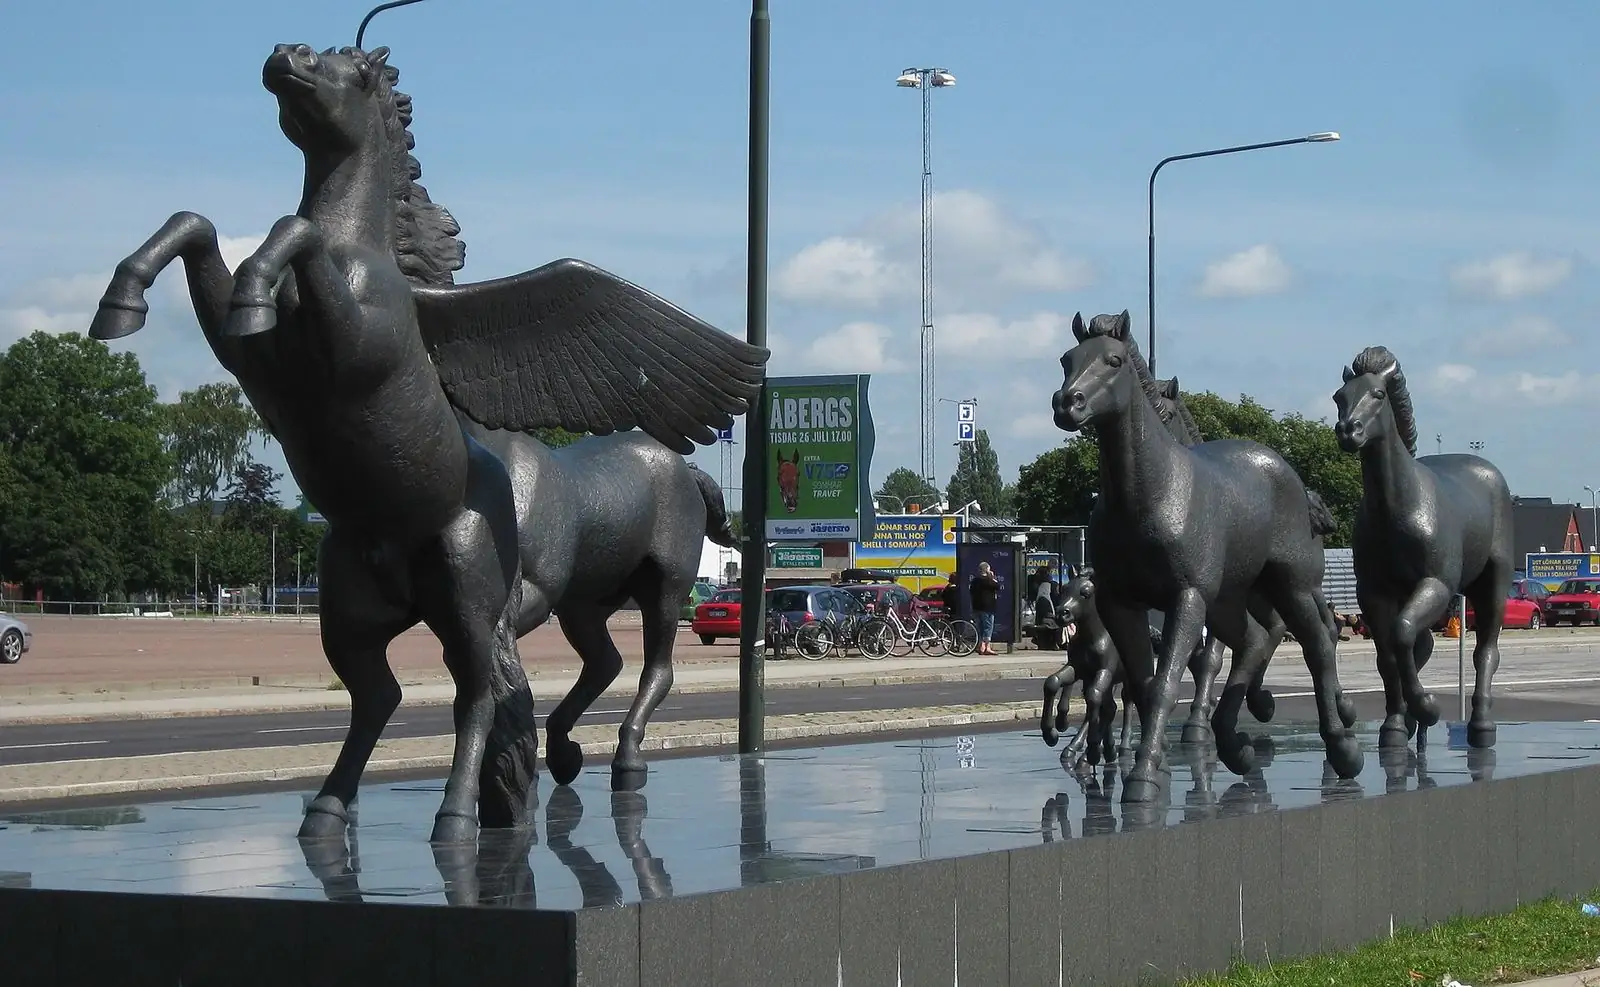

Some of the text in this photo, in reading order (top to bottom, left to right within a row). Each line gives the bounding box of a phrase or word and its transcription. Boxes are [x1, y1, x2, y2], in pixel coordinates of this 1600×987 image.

[770, 391, 852, 429] ÅBERGS
[962, 424, 971, 438] P
[770, 432, 797, 444] TISDAG
[812, 431, 829, 442] JULI
[831, 430, 852, 442] 17.00
[813, 489, 842, 498] TRAVET
[810, 522, 850, 533] Jägersro
[876, 522, 903, 531] LÖNAR
[918, 523, 931, 531] ATT
[894, 532, 907, 540] TILL
[908, 532, 925, 540] HOS
[862, 541, 883, 549] SHELL
